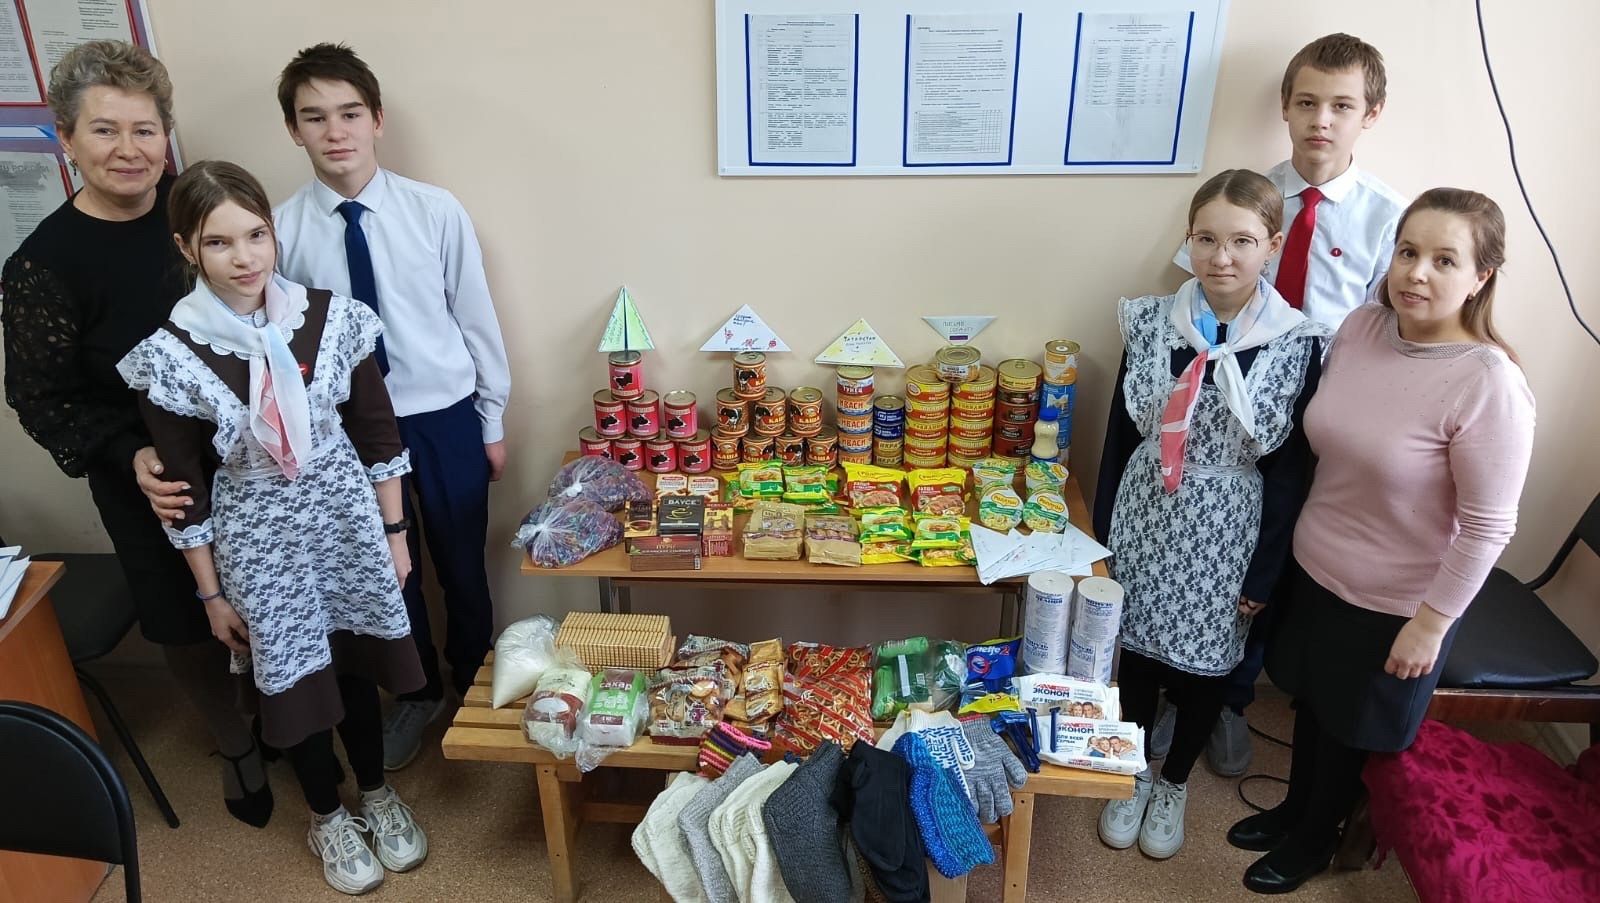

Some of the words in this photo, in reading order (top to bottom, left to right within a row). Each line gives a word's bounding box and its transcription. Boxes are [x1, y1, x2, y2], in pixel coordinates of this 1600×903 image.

[839, 400, 865, 409] ИВАСИ
[799, 415, 820, 424] КАША
[842, 419, 866, 428] ИВАСИ
[842, 438, 866, 447] ИВАСИ
[600, 681, 632, 690] сахар
[1033, 687, 1070, 697] ЭКОНОМ
